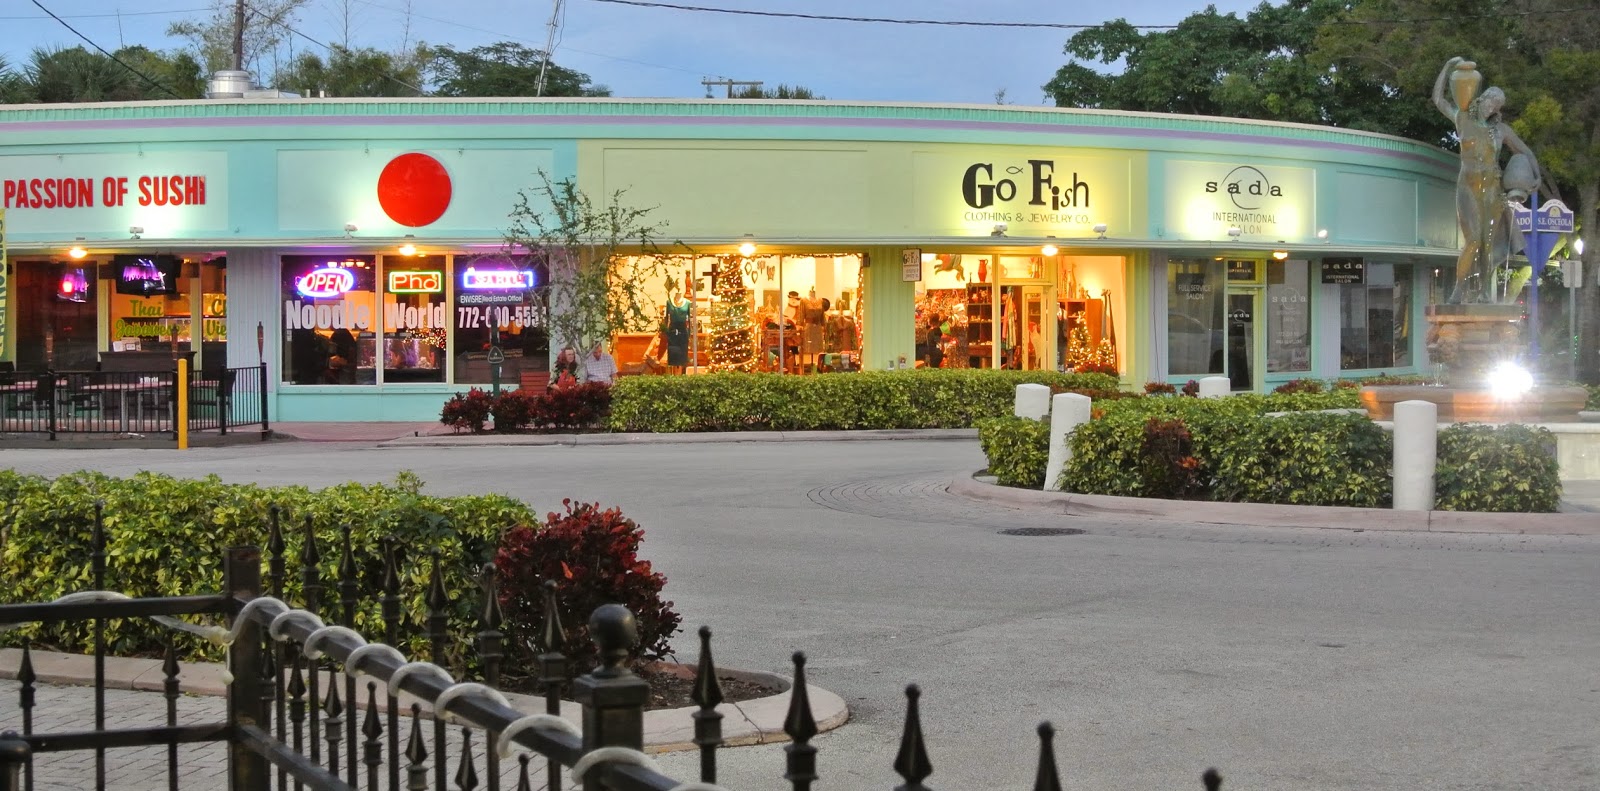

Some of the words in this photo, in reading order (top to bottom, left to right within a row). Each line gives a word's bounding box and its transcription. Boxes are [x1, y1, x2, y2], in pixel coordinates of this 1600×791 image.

[4, 178, 94, 209] PASSION
[102, 177, 128, 207] OF
[138, 175, 206, 207] SUSHI
[962, 163, 1017, 209] Go
[1028, 159, 1090, 211] Fish
[964, 211, 1012, 222] CLOTHING
[1015, 212, 1024, 222] &
[1028, 212, 1073, 223] JEWELRY
[1075, 214, 1091, 224] CO.
[1213, 212, 1276, 224] INTERNATIONAL
[1547, 218, 1572, 226] OSCEOLA
[304, 273, 347, 292] OPEN
[129, 300, 164, 316] Thai
[286, 300, 369, 329] Noodle
[386, 302, 446, 329] World
